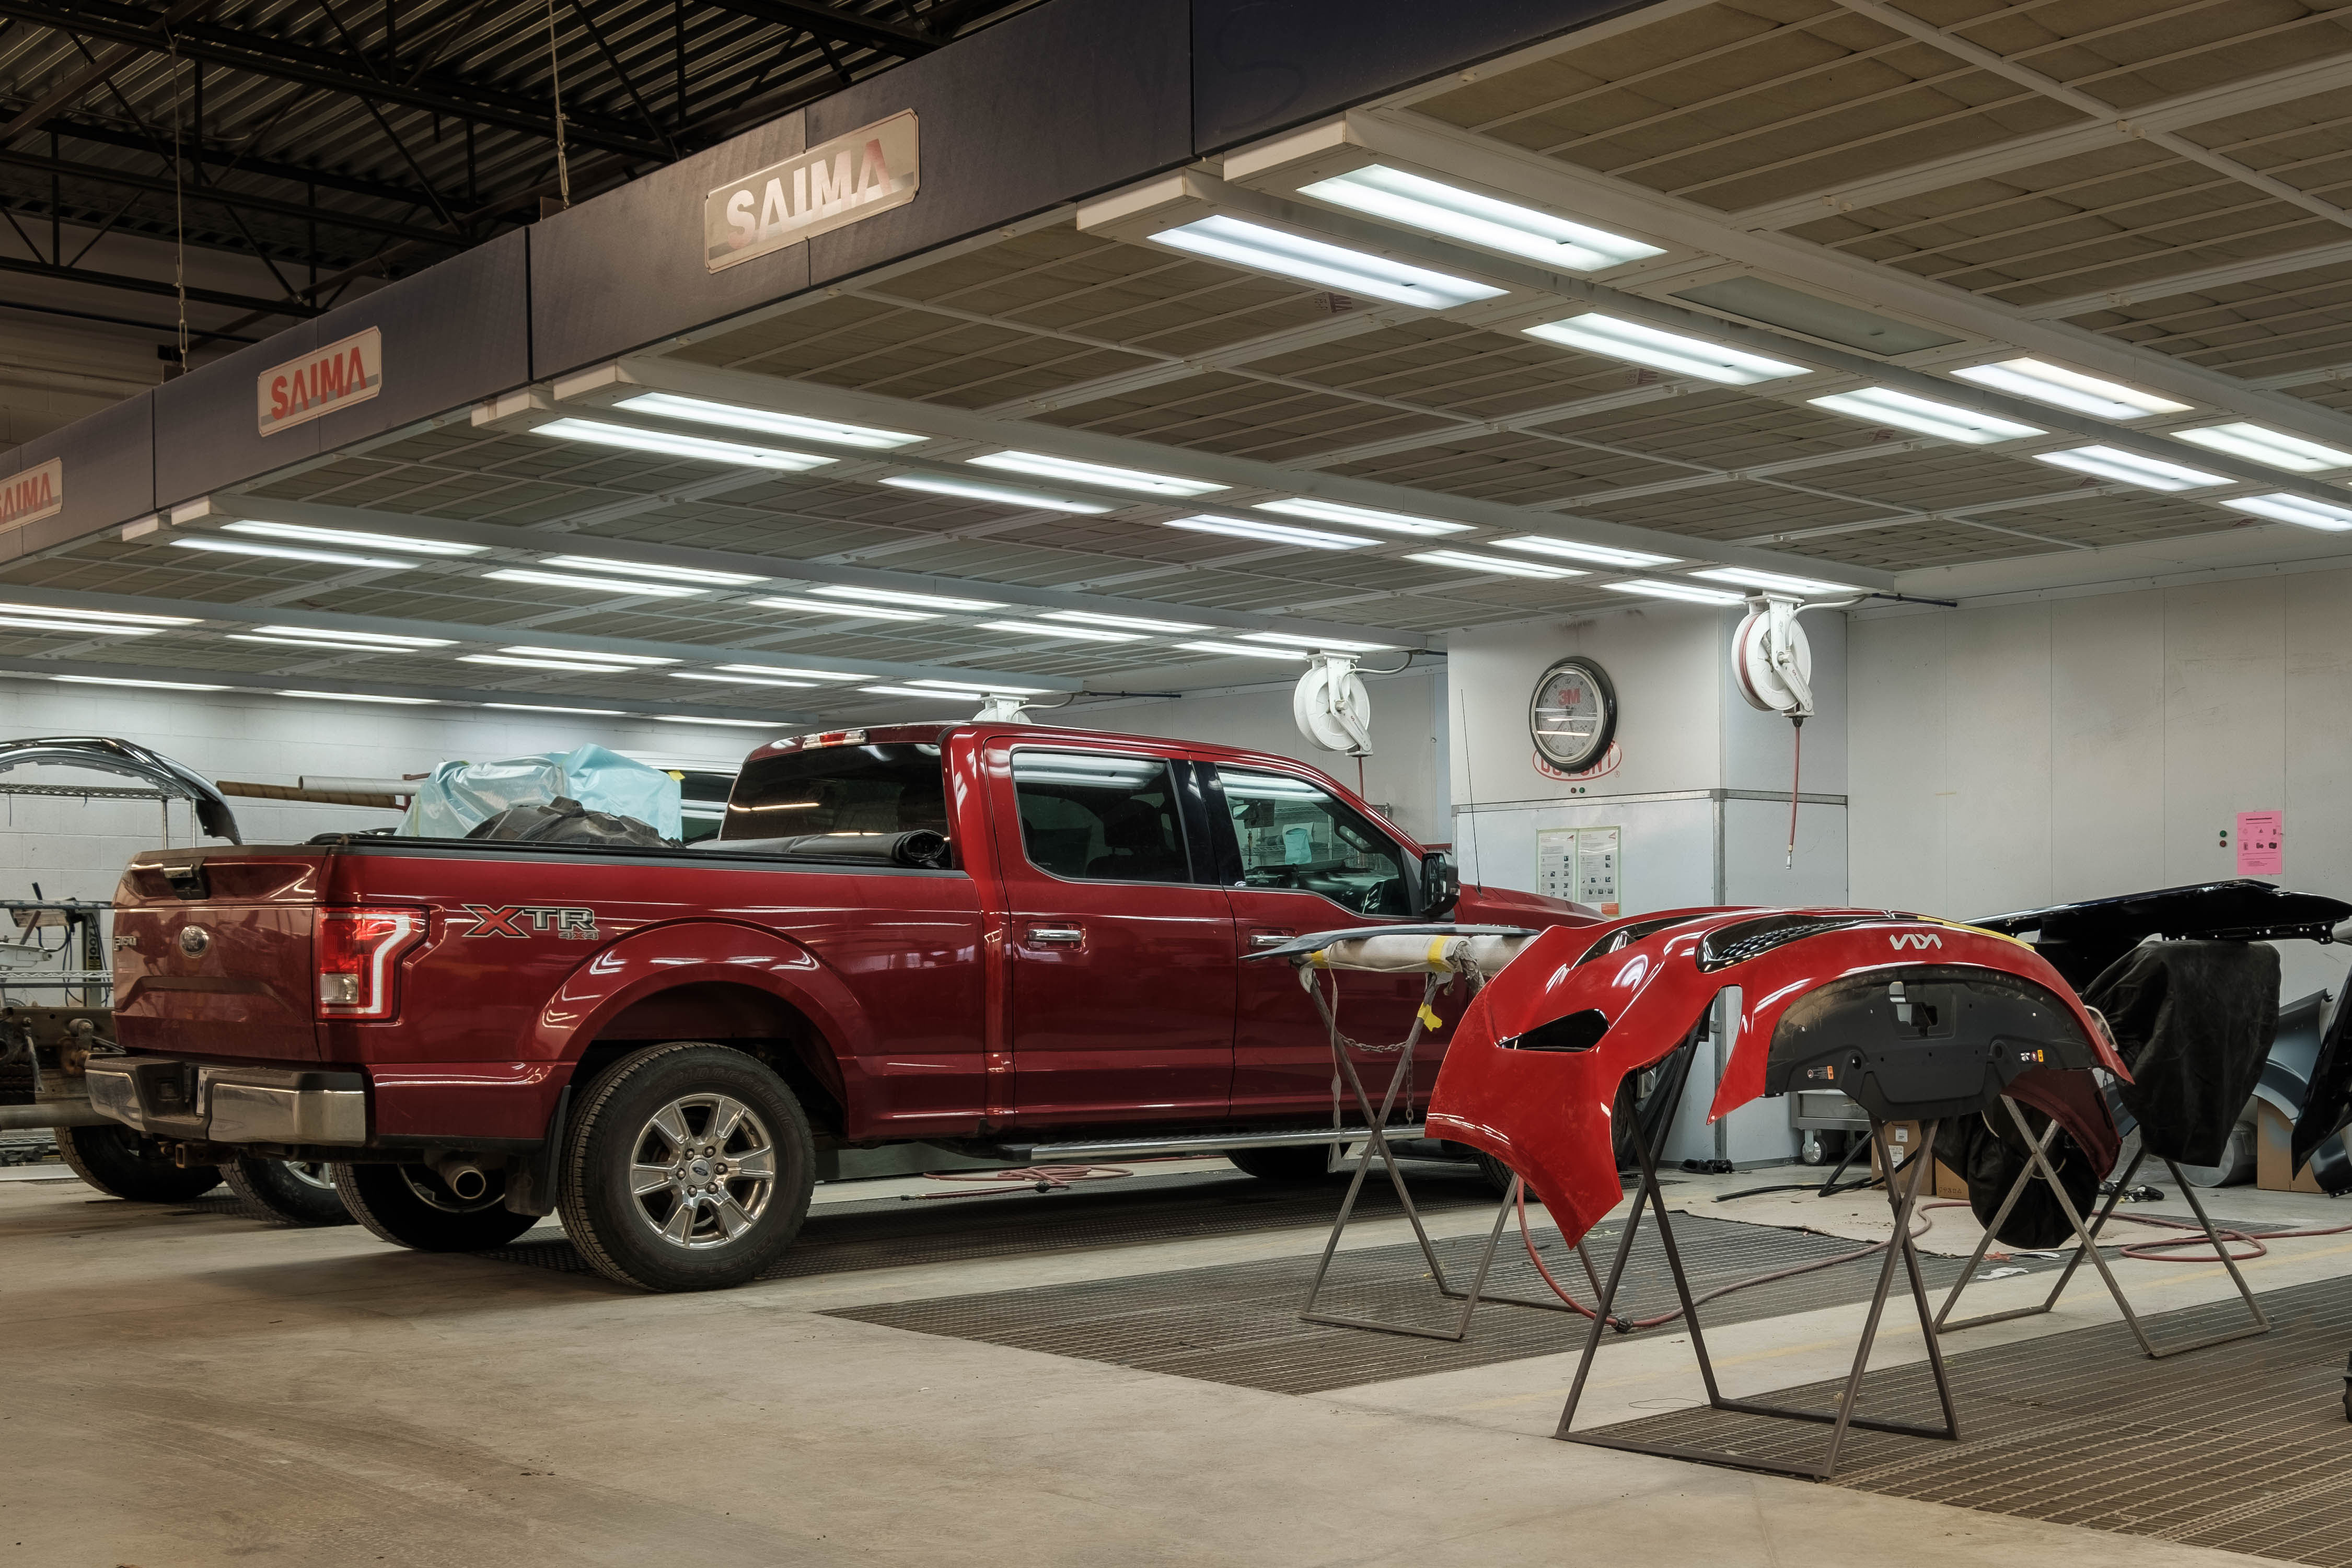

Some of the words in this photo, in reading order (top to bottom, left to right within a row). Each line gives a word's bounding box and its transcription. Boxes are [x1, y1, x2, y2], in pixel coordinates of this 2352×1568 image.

[726, 138, 892, 249] SAIMA
[271, 346, 367, 420] SAIMA
[0, 472, 52, 524] AIMA
[1558, 688, 1580, 705] 3M
[460, 903, 600, 938] XTR
